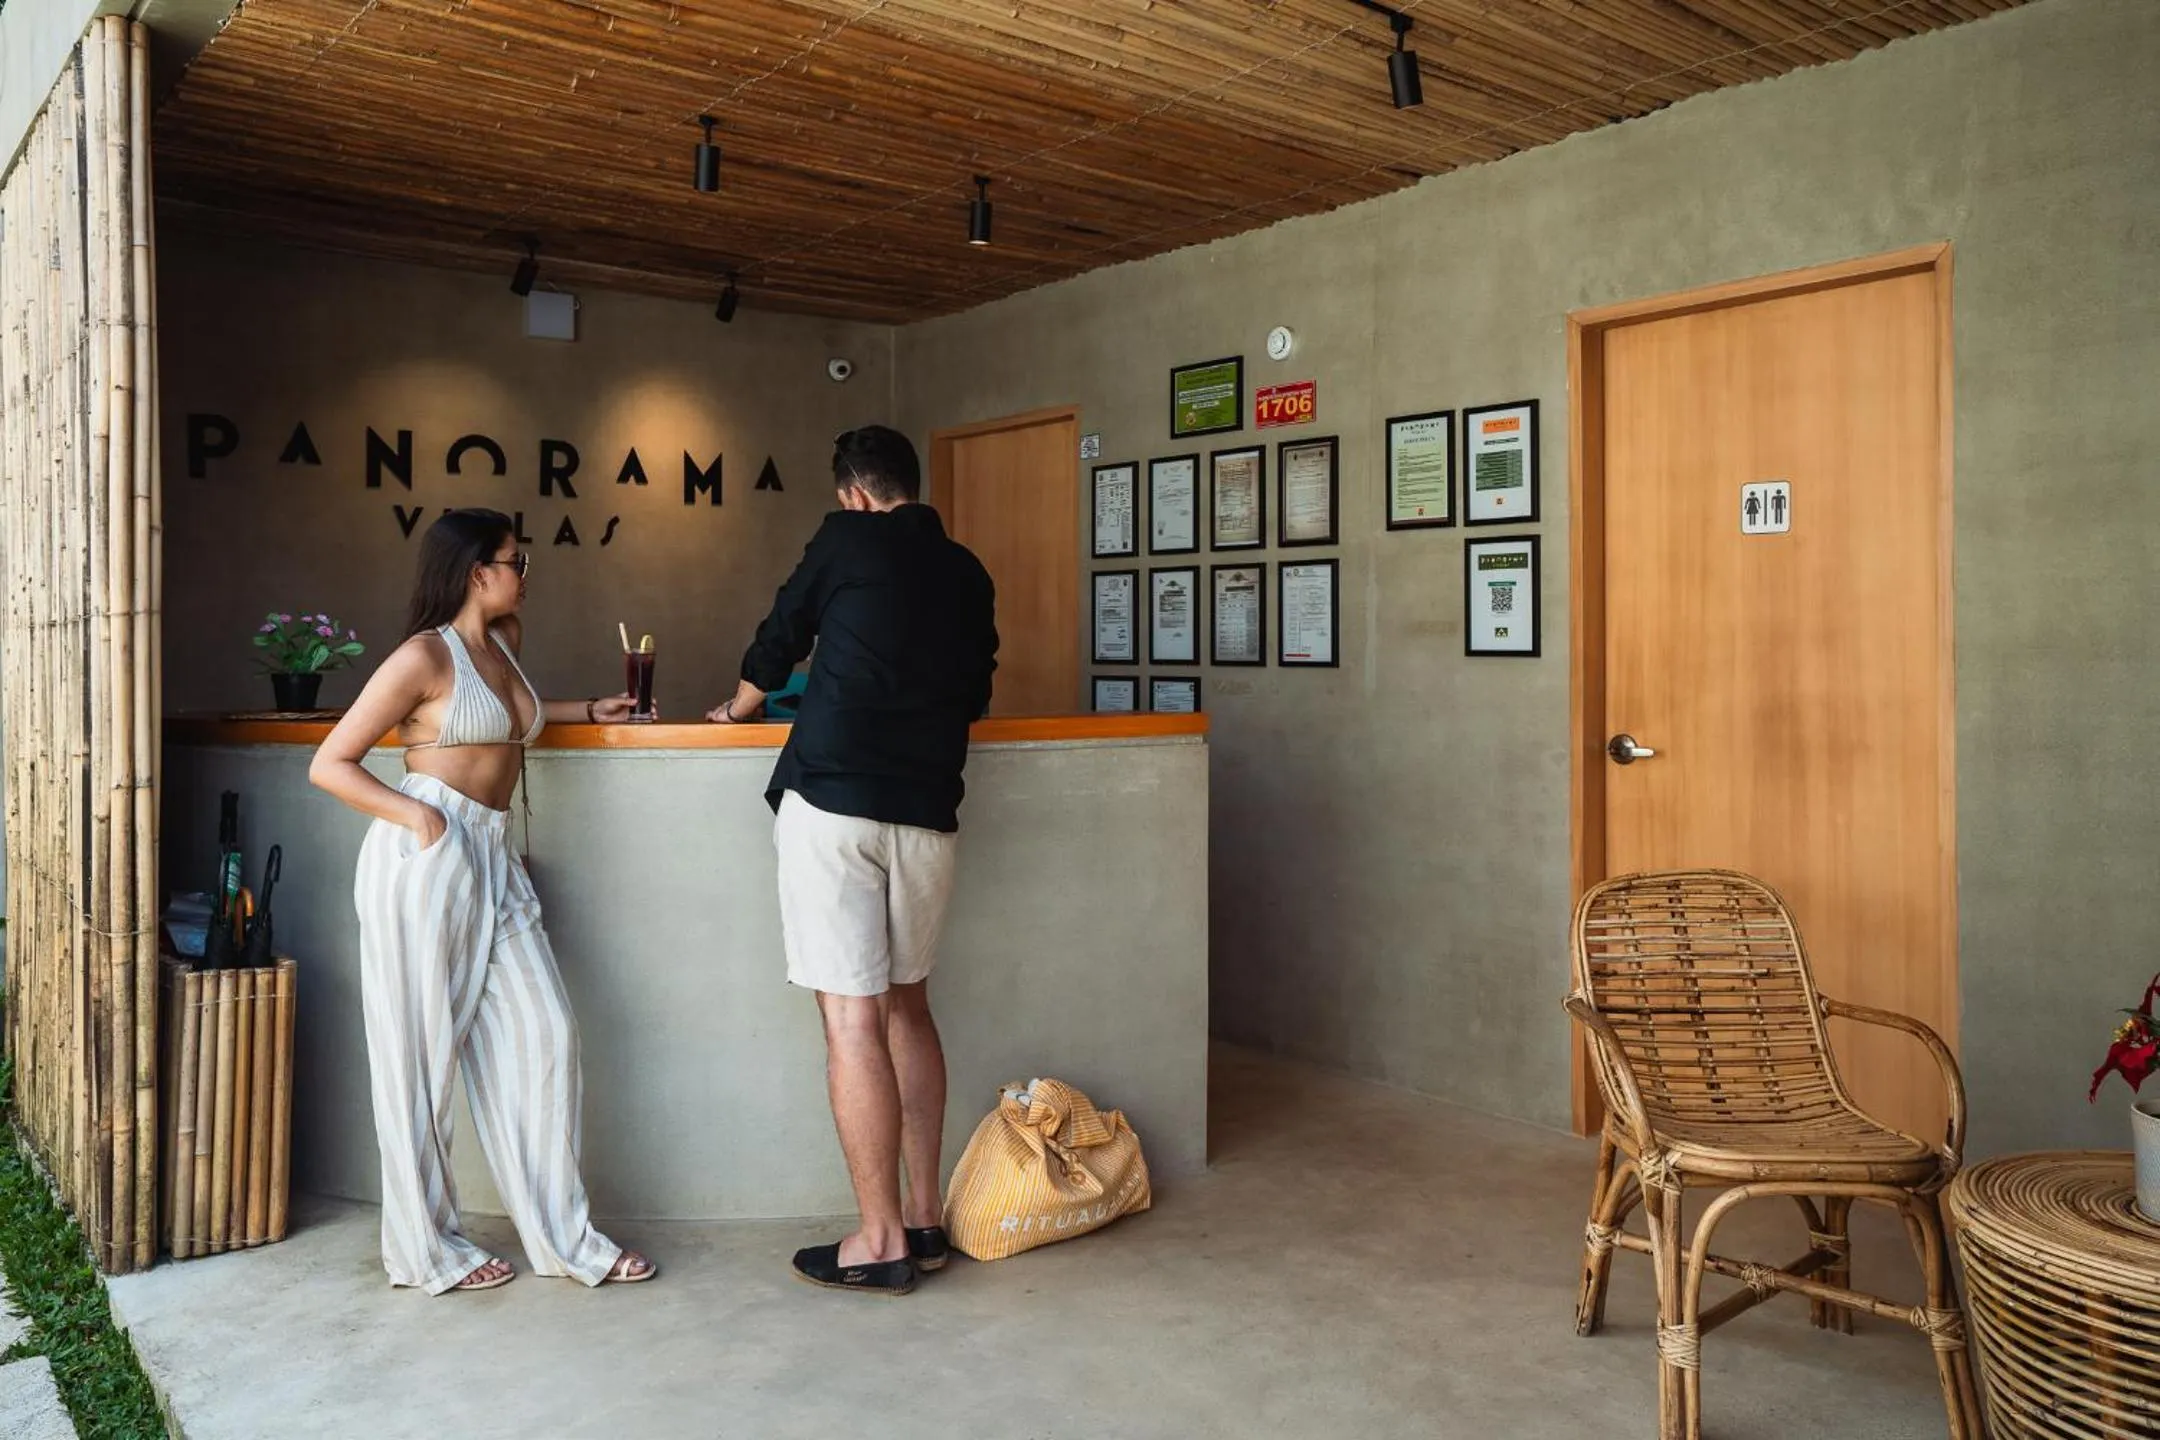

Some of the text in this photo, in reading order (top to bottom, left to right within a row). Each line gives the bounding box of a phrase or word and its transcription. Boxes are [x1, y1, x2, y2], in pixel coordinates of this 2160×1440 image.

[1258, 394, 1312, 418] 1706
[187, 412, 784, 506] PANORAMA
[393, 505, 620, 546] VLAS
